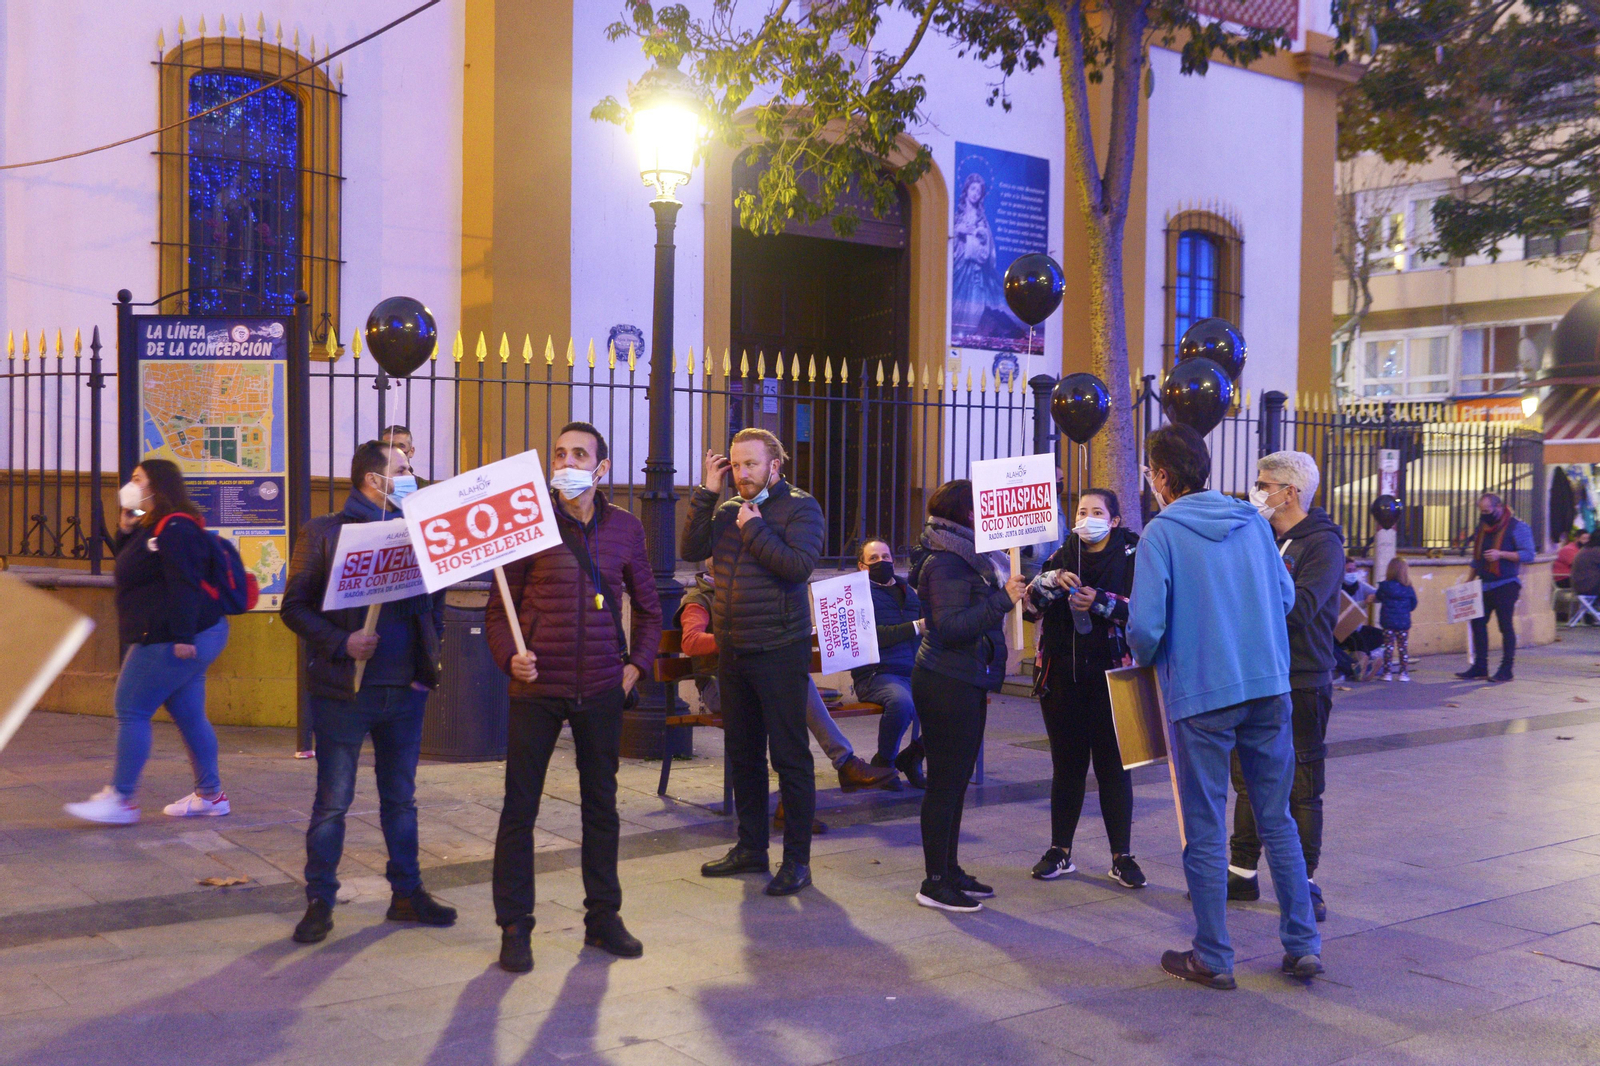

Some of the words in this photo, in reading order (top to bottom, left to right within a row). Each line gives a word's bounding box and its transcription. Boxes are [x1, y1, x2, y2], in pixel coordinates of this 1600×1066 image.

[146, 324, 162, 339] LA
[167, 321, 206, 339] LÍNEA
[147, 341, 165, 356] DE
[169, 341, 185, 356] LA
[189, 338, 272, 356] CONCEPCIÓN
[980, 491, 995, 517] SE
[996, 484, 1051, 515] TRASPASA
[424, 487, 540, 556] S.O.S
[982, 517, 1004, 532] OCIO
[1006, 510, 1052, 529] NOCTURNO
[435, 525, 545, 576] HOSTELERIA
[343, 552, 373, 577] SE
[337, 577, 362, 592] BAR
[365, 573, 390, 588] CON
[391, 568, 422, 584] DEUD
[829, 602, 837, 610] Y
[836, 597, 844, 605] A
[844, 584, 854, 607] NOS
[820, 596, 835, 658] IMPUESTOS
[830, 612, 842, 648] PAGAR
[838, 606, 850, 651] CERRAR
[847, 608, 860, 658] OBLIGAIS
